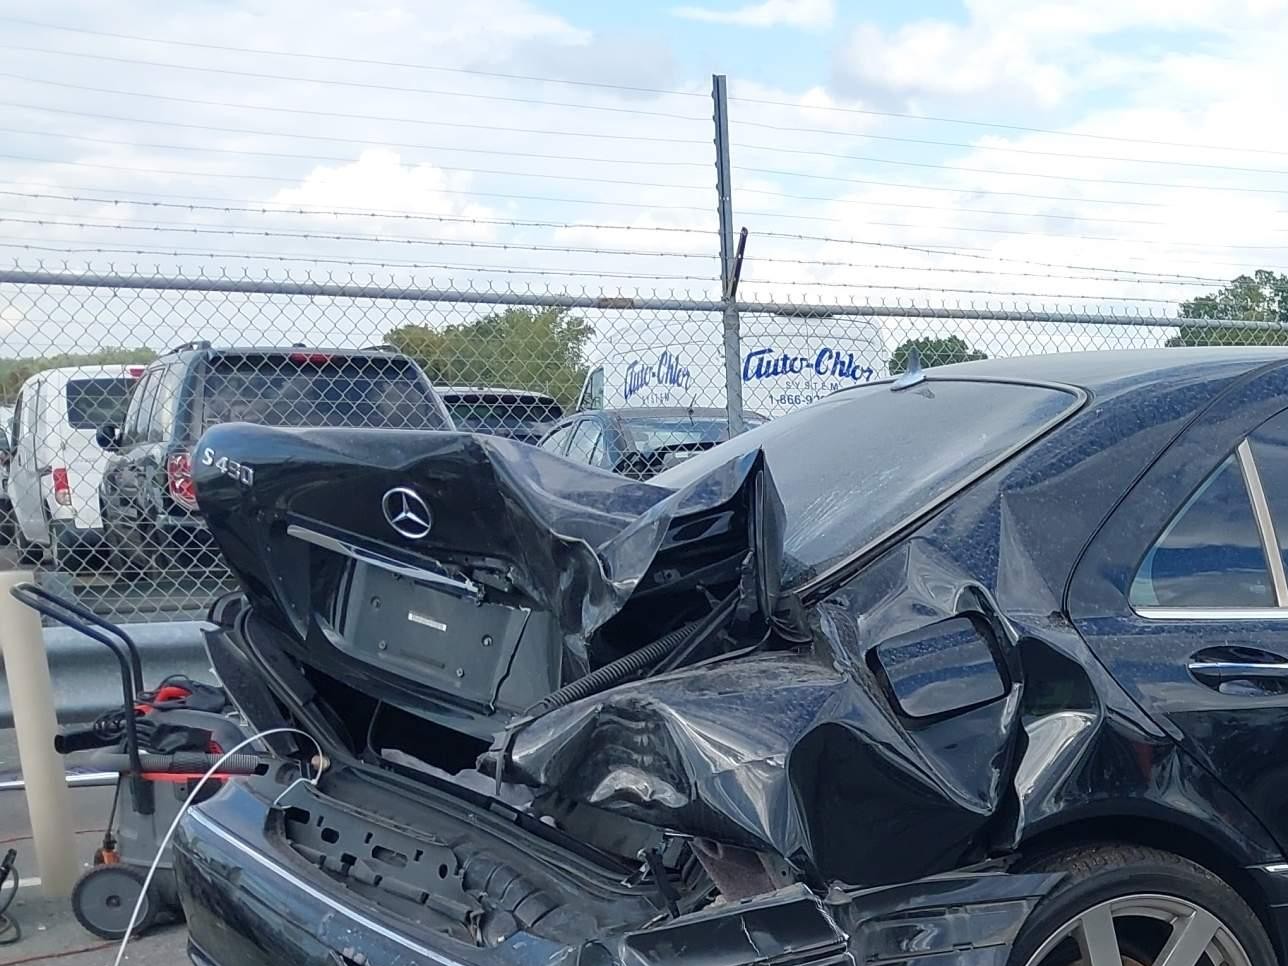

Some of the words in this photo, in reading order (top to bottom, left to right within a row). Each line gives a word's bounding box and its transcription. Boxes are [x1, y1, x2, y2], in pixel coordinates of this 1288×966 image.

[624, 351, 691, 400] Auto-Chlor
[743, 347, 873, 382] Auto-Chlor
[785, 381, 839, 391] SYSTEM
[202, 447, 215, 465] S
[216, 456, 254, 487] 430
